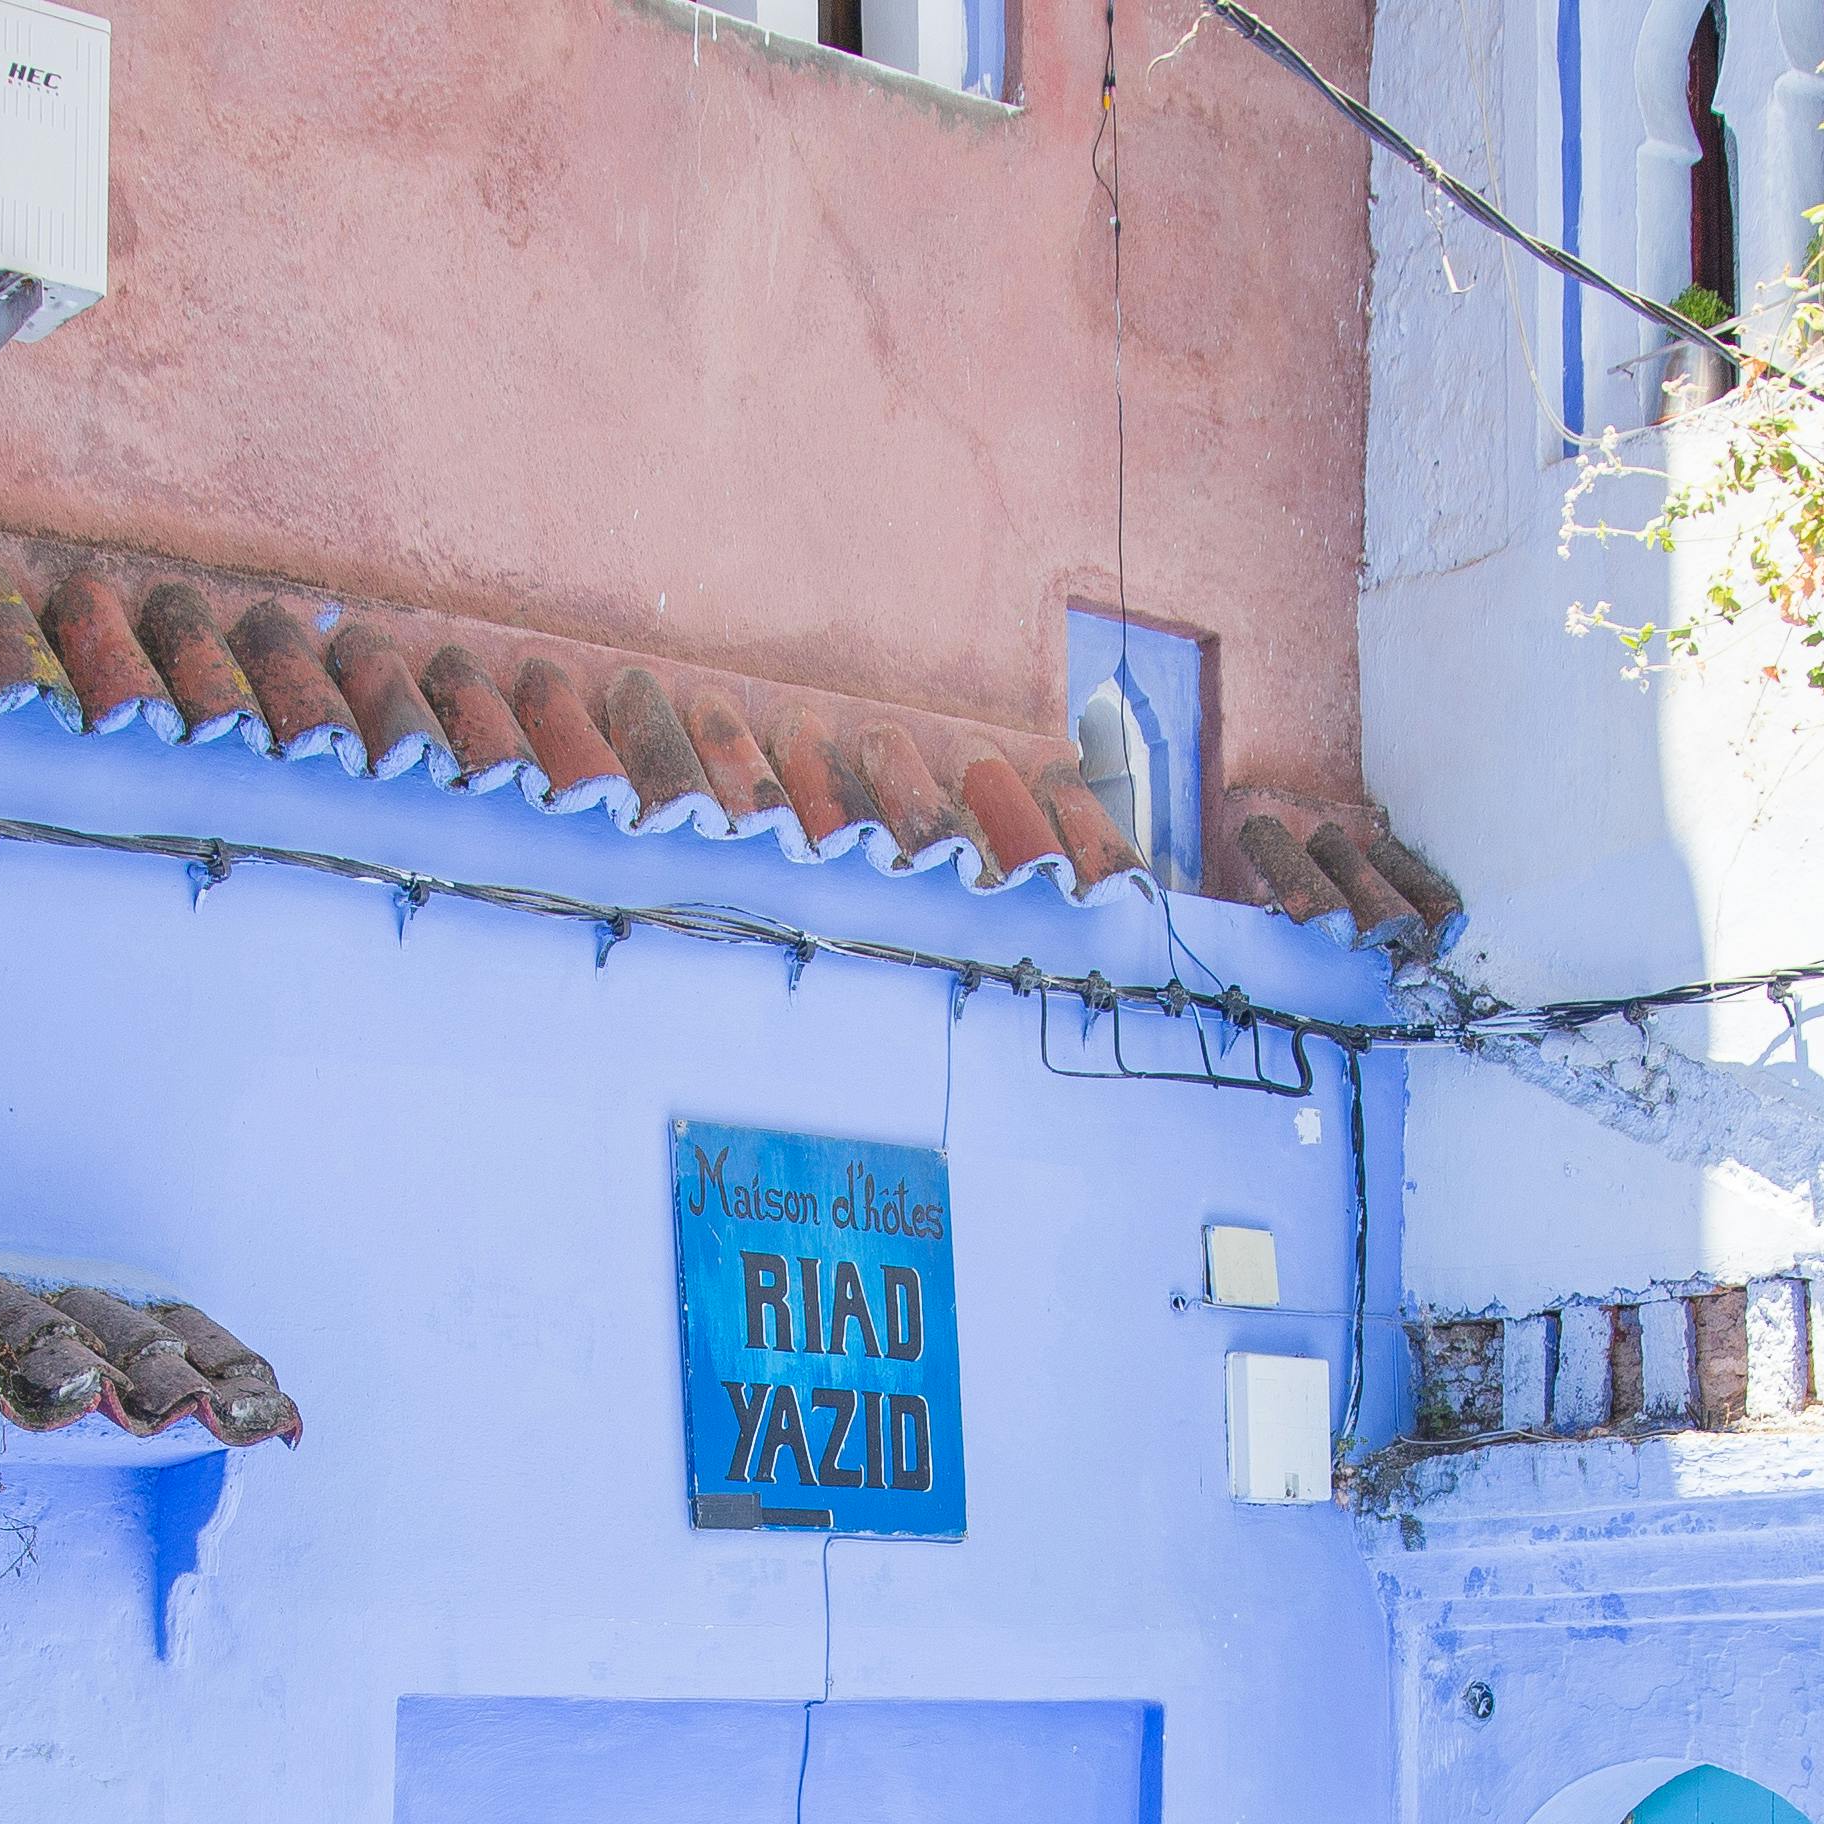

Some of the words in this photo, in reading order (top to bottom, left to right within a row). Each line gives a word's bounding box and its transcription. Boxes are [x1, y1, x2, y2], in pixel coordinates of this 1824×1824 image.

[8, 61, 62, 90] HEC
[688, 1144, 821, 1226] Maison
[832, 1160, 944, 1241] d'hôtes
[739, 1249, 924, 1362] RIAD
[720, 1381, 933, 1493] YAZID
